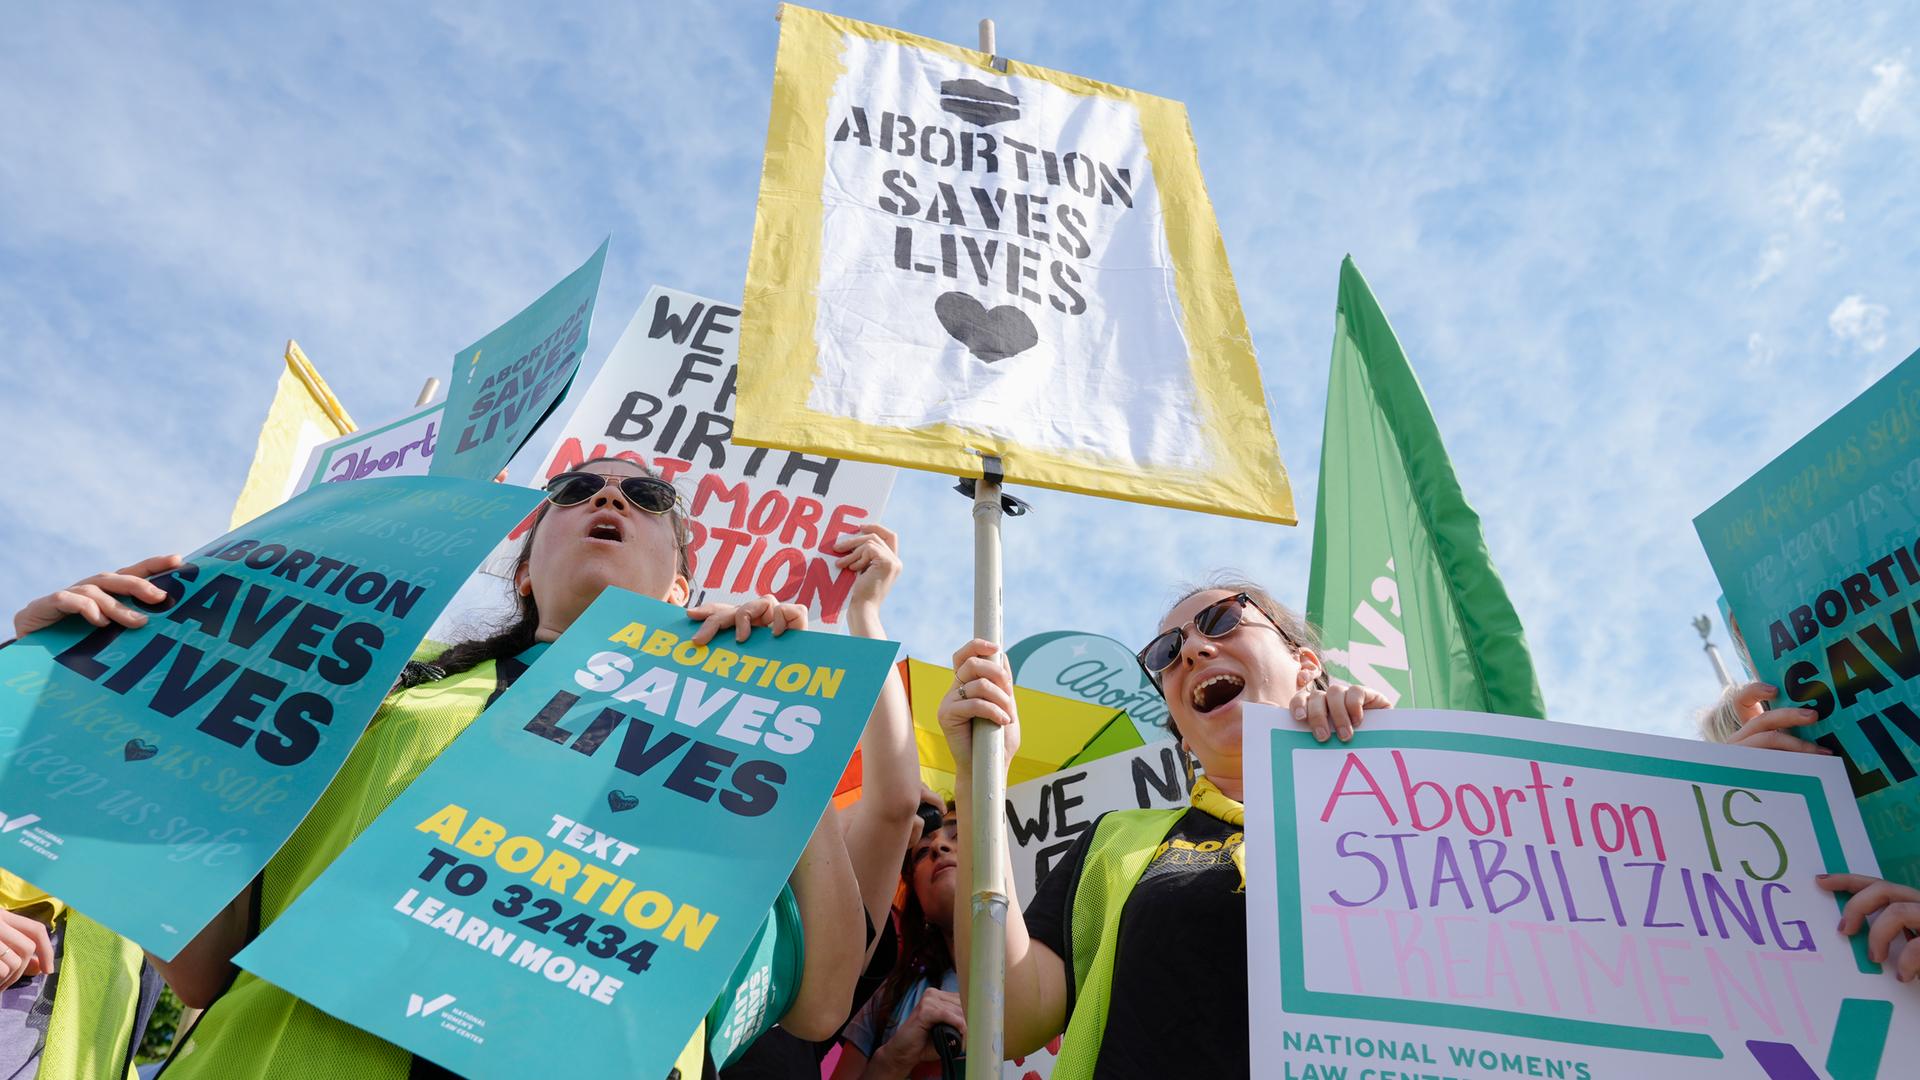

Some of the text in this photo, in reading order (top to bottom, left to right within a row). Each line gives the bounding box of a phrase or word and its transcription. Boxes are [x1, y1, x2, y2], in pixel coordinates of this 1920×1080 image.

[833, 105, 1133, 208] ABORTION
[879, 170, 1091, 259] SAVES
[648, 295, 742, 355] WE
[894, 226, 1087, 316] LIVES
[468, 320, 584, 421] SAVES
[478, 298, 590, 394] ABORTION
[545, 437, 868, 558] NT MORE
[131, 563, 385, 686] SAVES
[1769, 535, 1920, 661] ABORTI
[53, 620, 335, 767] LIVES
[574, 651, 821, 755] SAVES
[608, 621, 846, 699] ABORTION
[1784, 599, 1920, 722] SAV
[522, 689, 787, 817] LIVES
[546, 813, 640, 867] TEXT
[1005, 771, 1092, 848] WE
[1320, 750, 1788, 881] Abortion IS
[415, 803, 720, 952] ABORTION
[418, 847, 660, 975] TO 32434
[1328, 831, 1817, 952] STABILIZING
[393, 888, 625, 1006] LEARN MORE
[1310, 904, 1825, 1045] TREATMENT
[1283, 1031, 1592, 1080] NATIONAL WOMEN'S
[1284, 1061, 1348, 1080] LAW
